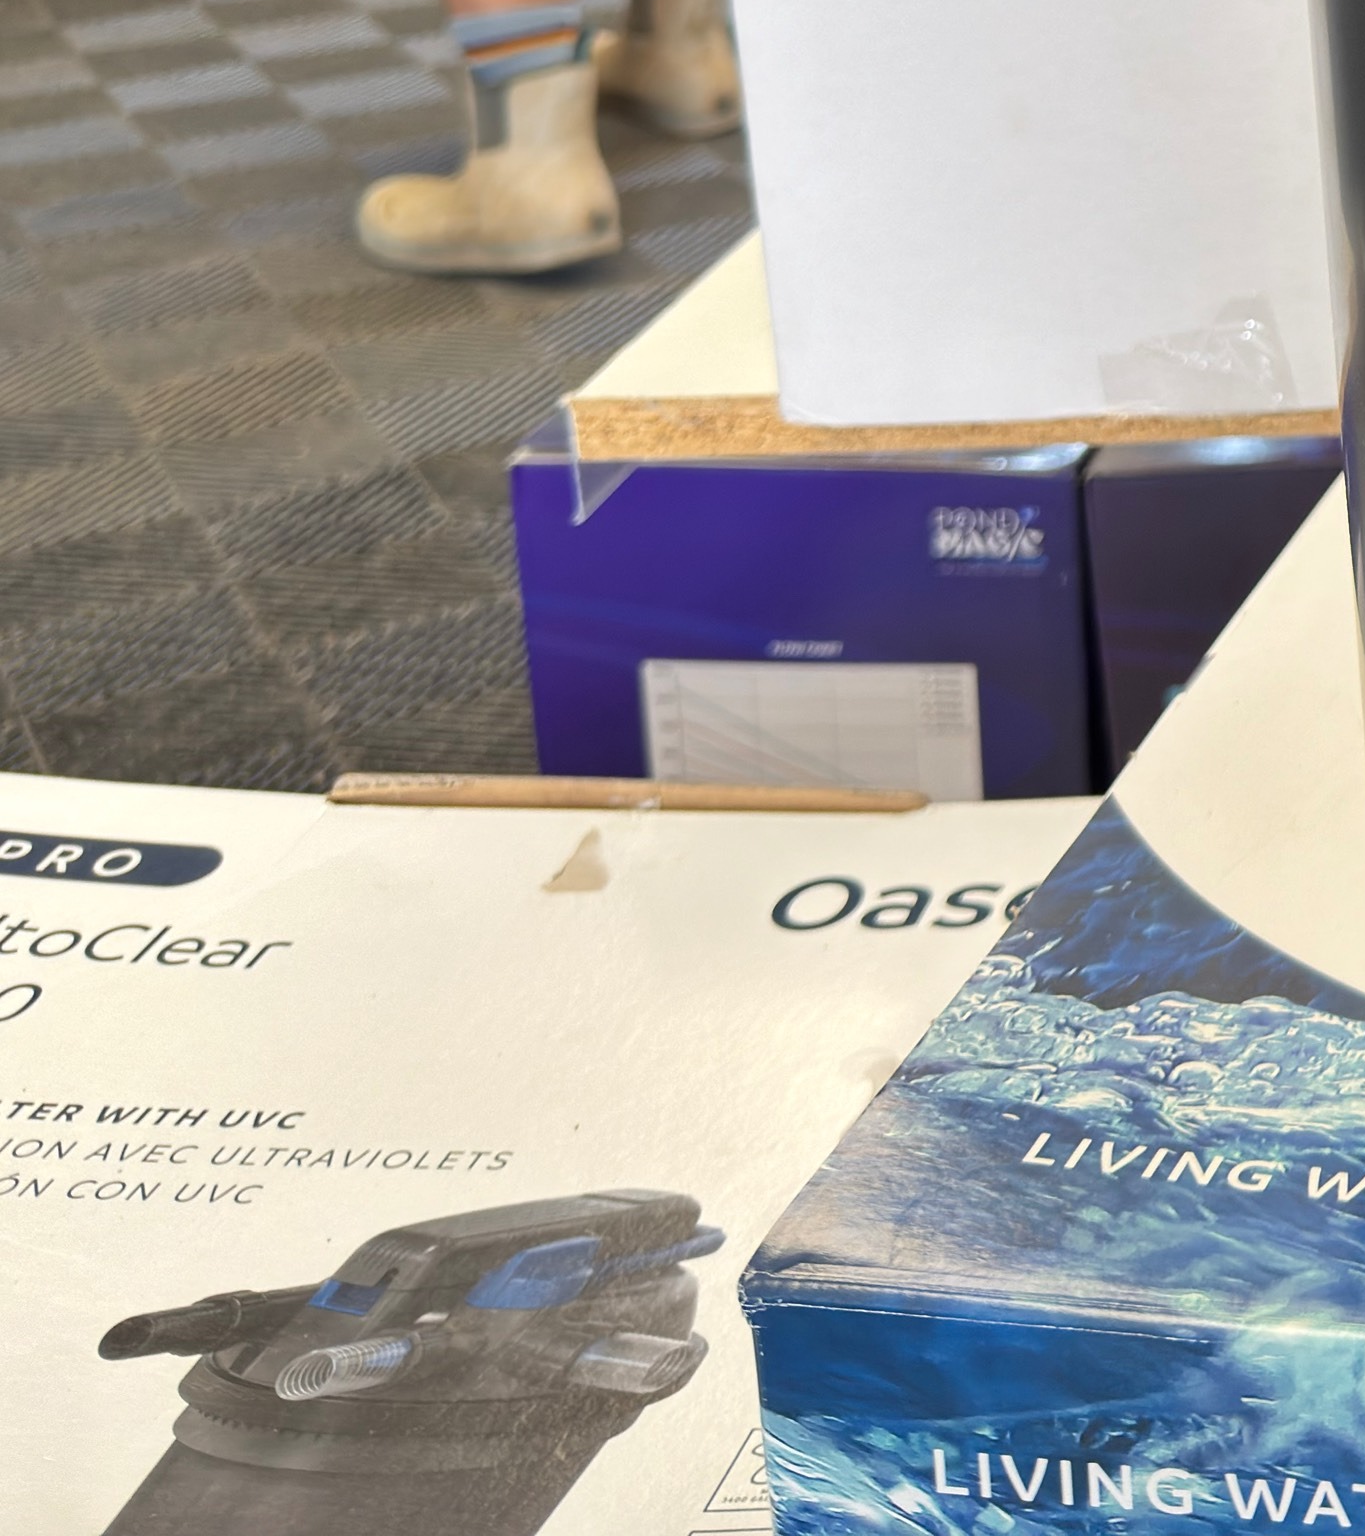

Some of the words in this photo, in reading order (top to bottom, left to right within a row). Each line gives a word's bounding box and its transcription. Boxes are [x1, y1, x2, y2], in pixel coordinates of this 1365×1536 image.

[0, 1100, 84, 1122] TER
[96, 1105, 208, 1127] WITH
[219, 1109, 305, 1130] UVC
[84, 1142, 199, 1164] AVEC
[211, 1147, 514, 1171] ULTRAVIOLETS
[1022, 1132, 1274, 1193] LIVING
[66, 1179, 161, 1201] CON
[174, 1183, 263, 1204] UVC
[933, 1448, 1194, 1516] LIVING
